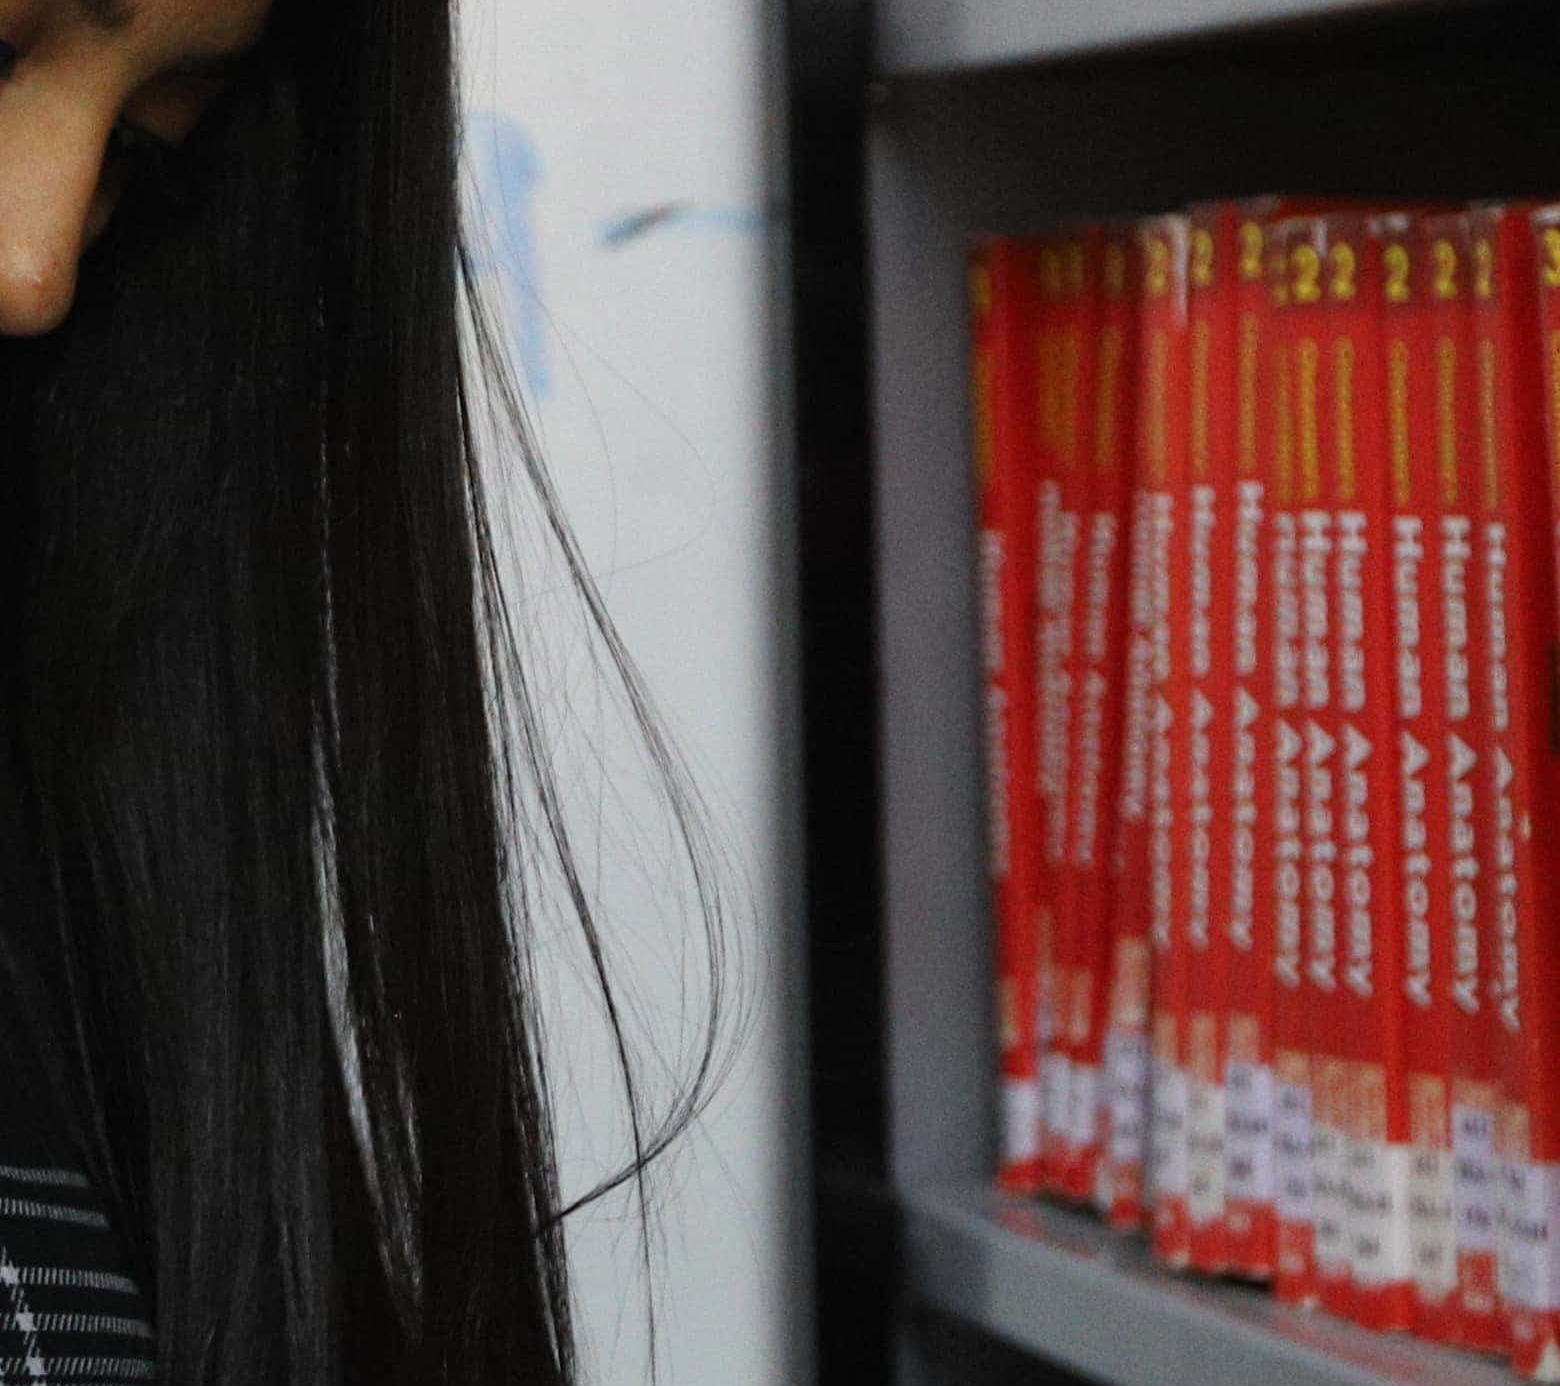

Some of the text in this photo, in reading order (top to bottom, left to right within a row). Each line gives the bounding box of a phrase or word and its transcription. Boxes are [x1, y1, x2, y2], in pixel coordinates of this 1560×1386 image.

[1291, 243, 1321, 302] 2
[1330, 240, 1356, 300] 2
[1384, 242, 1410, 303] 2
[1432, 238, 1457, 300] 2
[1301, 508, 1337, 992] Human Anatomy
[1337, 509, 1374, 999] Human Anatomy
[1394, 515, 1431, 1006] Human Anatomy
[1441, 515, 1480, 1012] Human Anatomy
